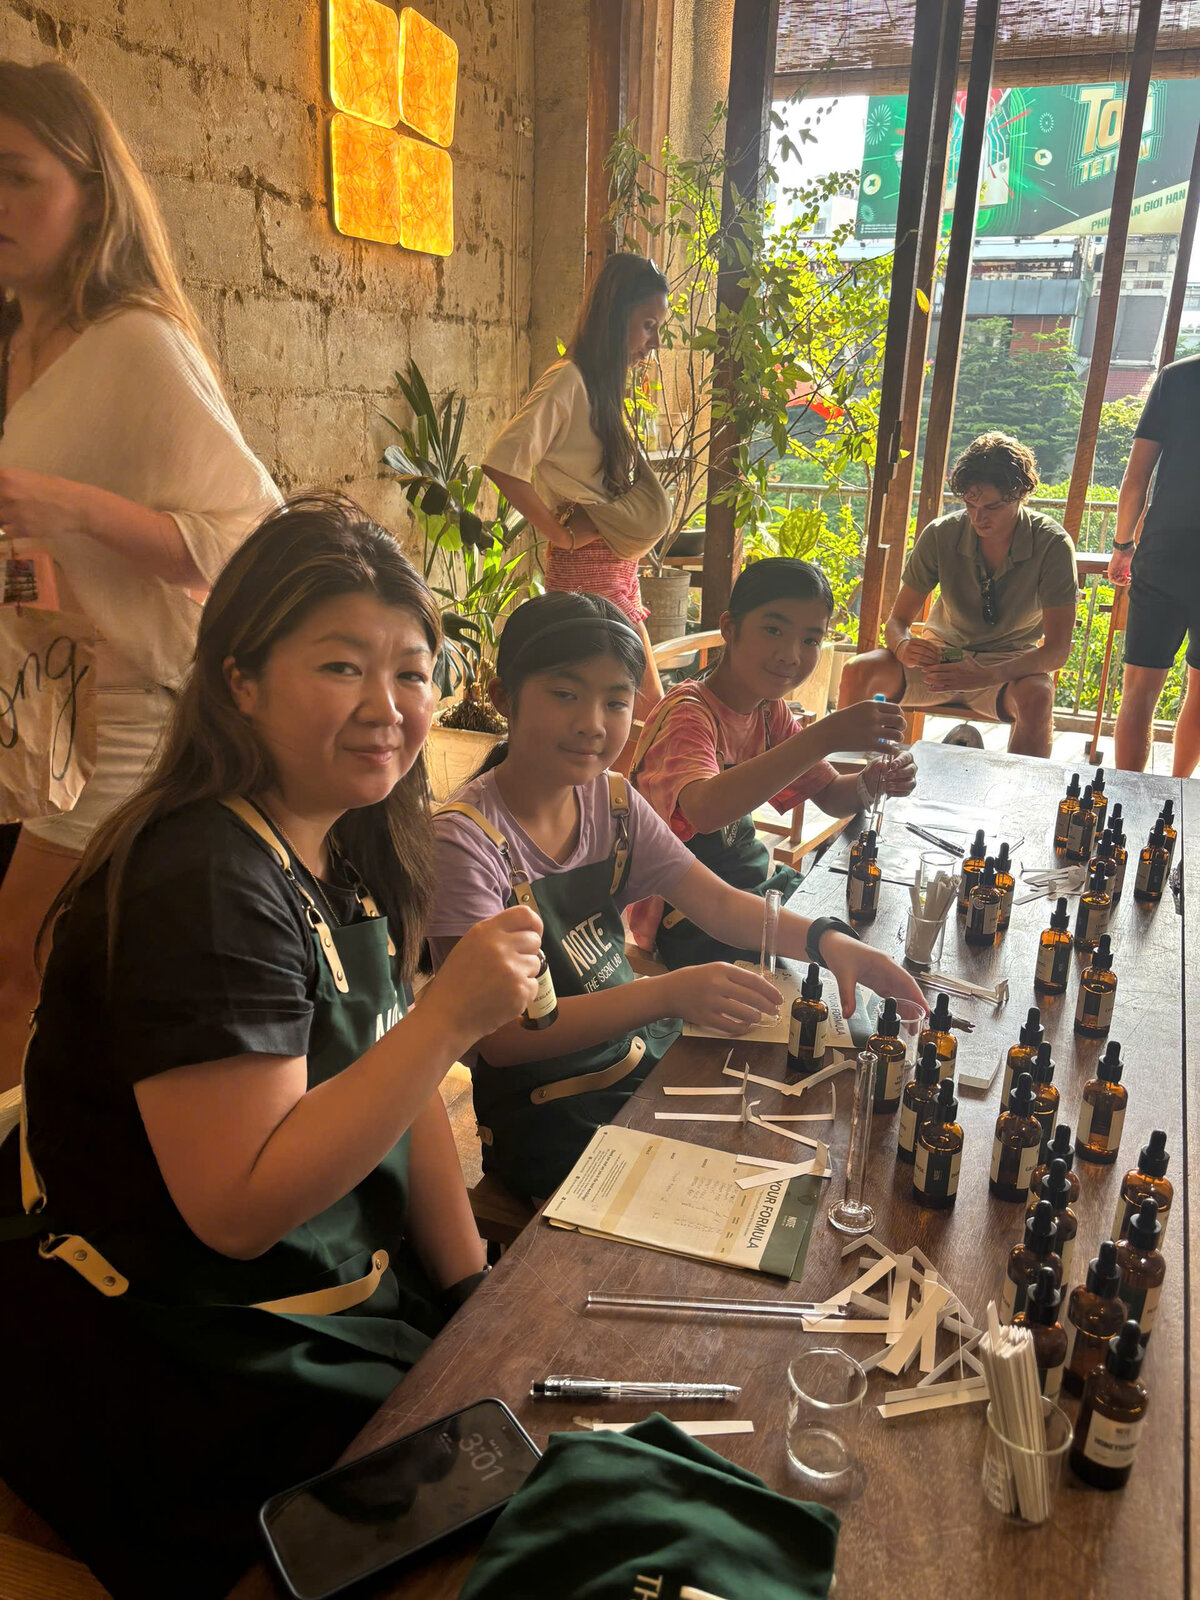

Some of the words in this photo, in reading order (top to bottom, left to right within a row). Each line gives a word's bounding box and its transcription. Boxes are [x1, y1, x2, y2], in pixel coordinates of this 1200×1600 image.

[584, 976, 600, 994] THE
[597, 961, 616, 983] SCENT
[611, 952, 623, 968] LAB
[764, 1180, 784, 1205] YOUR
[746, 1205, 774, 1249] FORMULA
[459, 1433, 504, 1481] 3:01
[633, 1574, 663, 1600] TH
